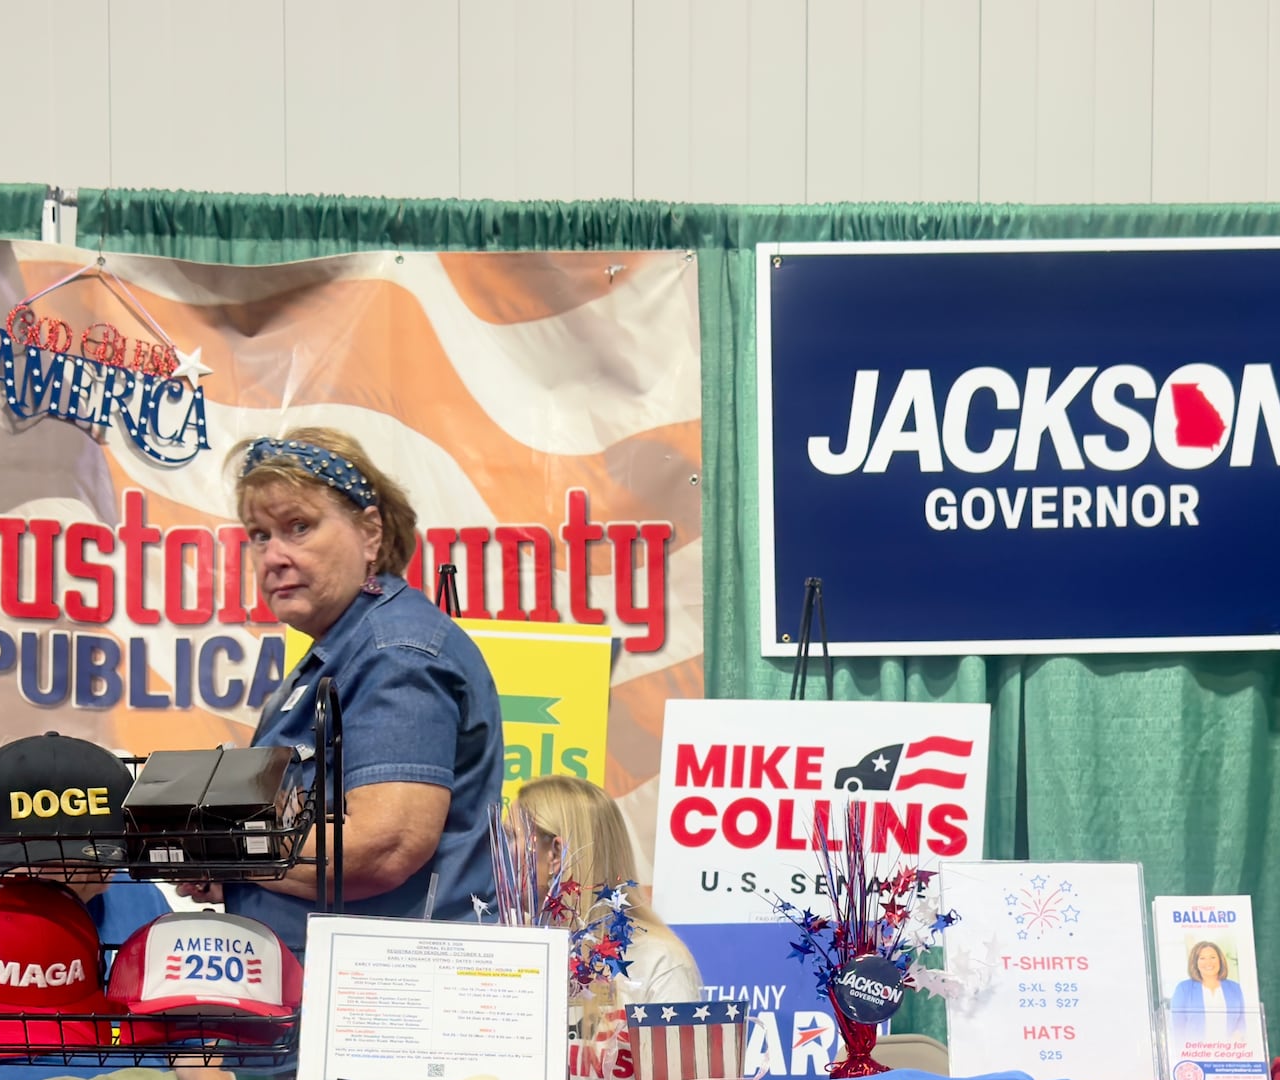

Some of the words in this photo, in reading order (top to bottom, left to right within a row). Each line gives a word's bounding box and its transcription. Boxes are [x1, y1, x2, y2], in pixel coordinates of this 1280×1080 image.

[6, 304, 72, 353] GOD
[925, 484, 1200, 530] GOVERNOR
[407, 488, 672, 654] unty
[675, 744, 825, 790] MIKE
[10, 787, 111, 819] DOGE
[670, 796, 968, 857] COLLINS
[701, 871, 771, 894] U.S.
[790, 872, 926, 898] SENAE
[1173, 910, 1236, 923] BALLARD
[173, 937, 255, 955] AMERICA
[185, 954, 244, 982] 250
[1001, 956, 1089, 971] T-SHIRTS
[704, 985, 786, 1010] THANY
[838, 971, 902, 1003] JACKSON
[850, 989, 885, 1006] GOVERNOR
[1018, 982, 1046, 993] S-XL
[1055, 981, 1078, 993] $25
[1019, 998, 1047, 1008] 2X-3
[1056, 997, 1079, 1009] $27
[1023, 1025, 1076, 1041] HATS
[1039, 1050, 1063, 1061] $25
[1185, 1041, 1231, 1050] Delivering
[1233, 1041, 1247, 1049] for
[1214, 1051, 1253, 1059] Georgia!
